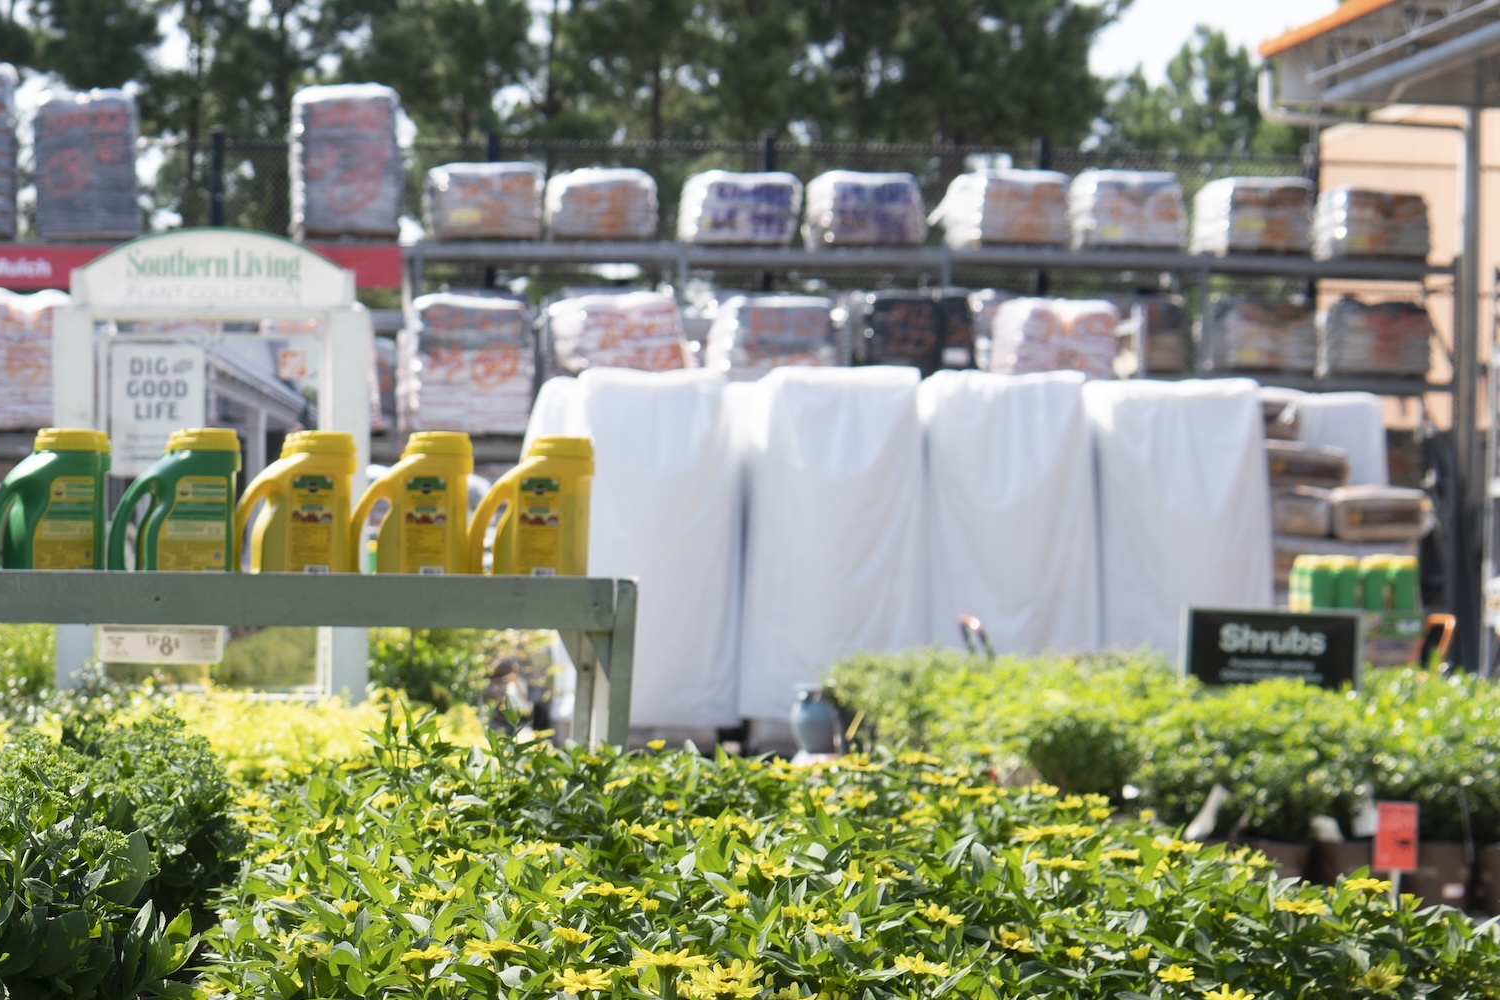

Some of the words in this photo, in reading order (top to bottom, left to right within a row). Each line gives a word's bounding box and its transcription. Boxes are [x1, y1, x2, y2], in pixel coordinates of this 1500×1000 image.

[126, 247, 228, 279] Southern
[232, 247, 302, 284] Living
[130, 357, 168, 376] DIG
[126, 380, 188, 398] GOOD
[134, 402, 179, 420] LIFE
[1218, 622, 1328, 656] Shrubs
